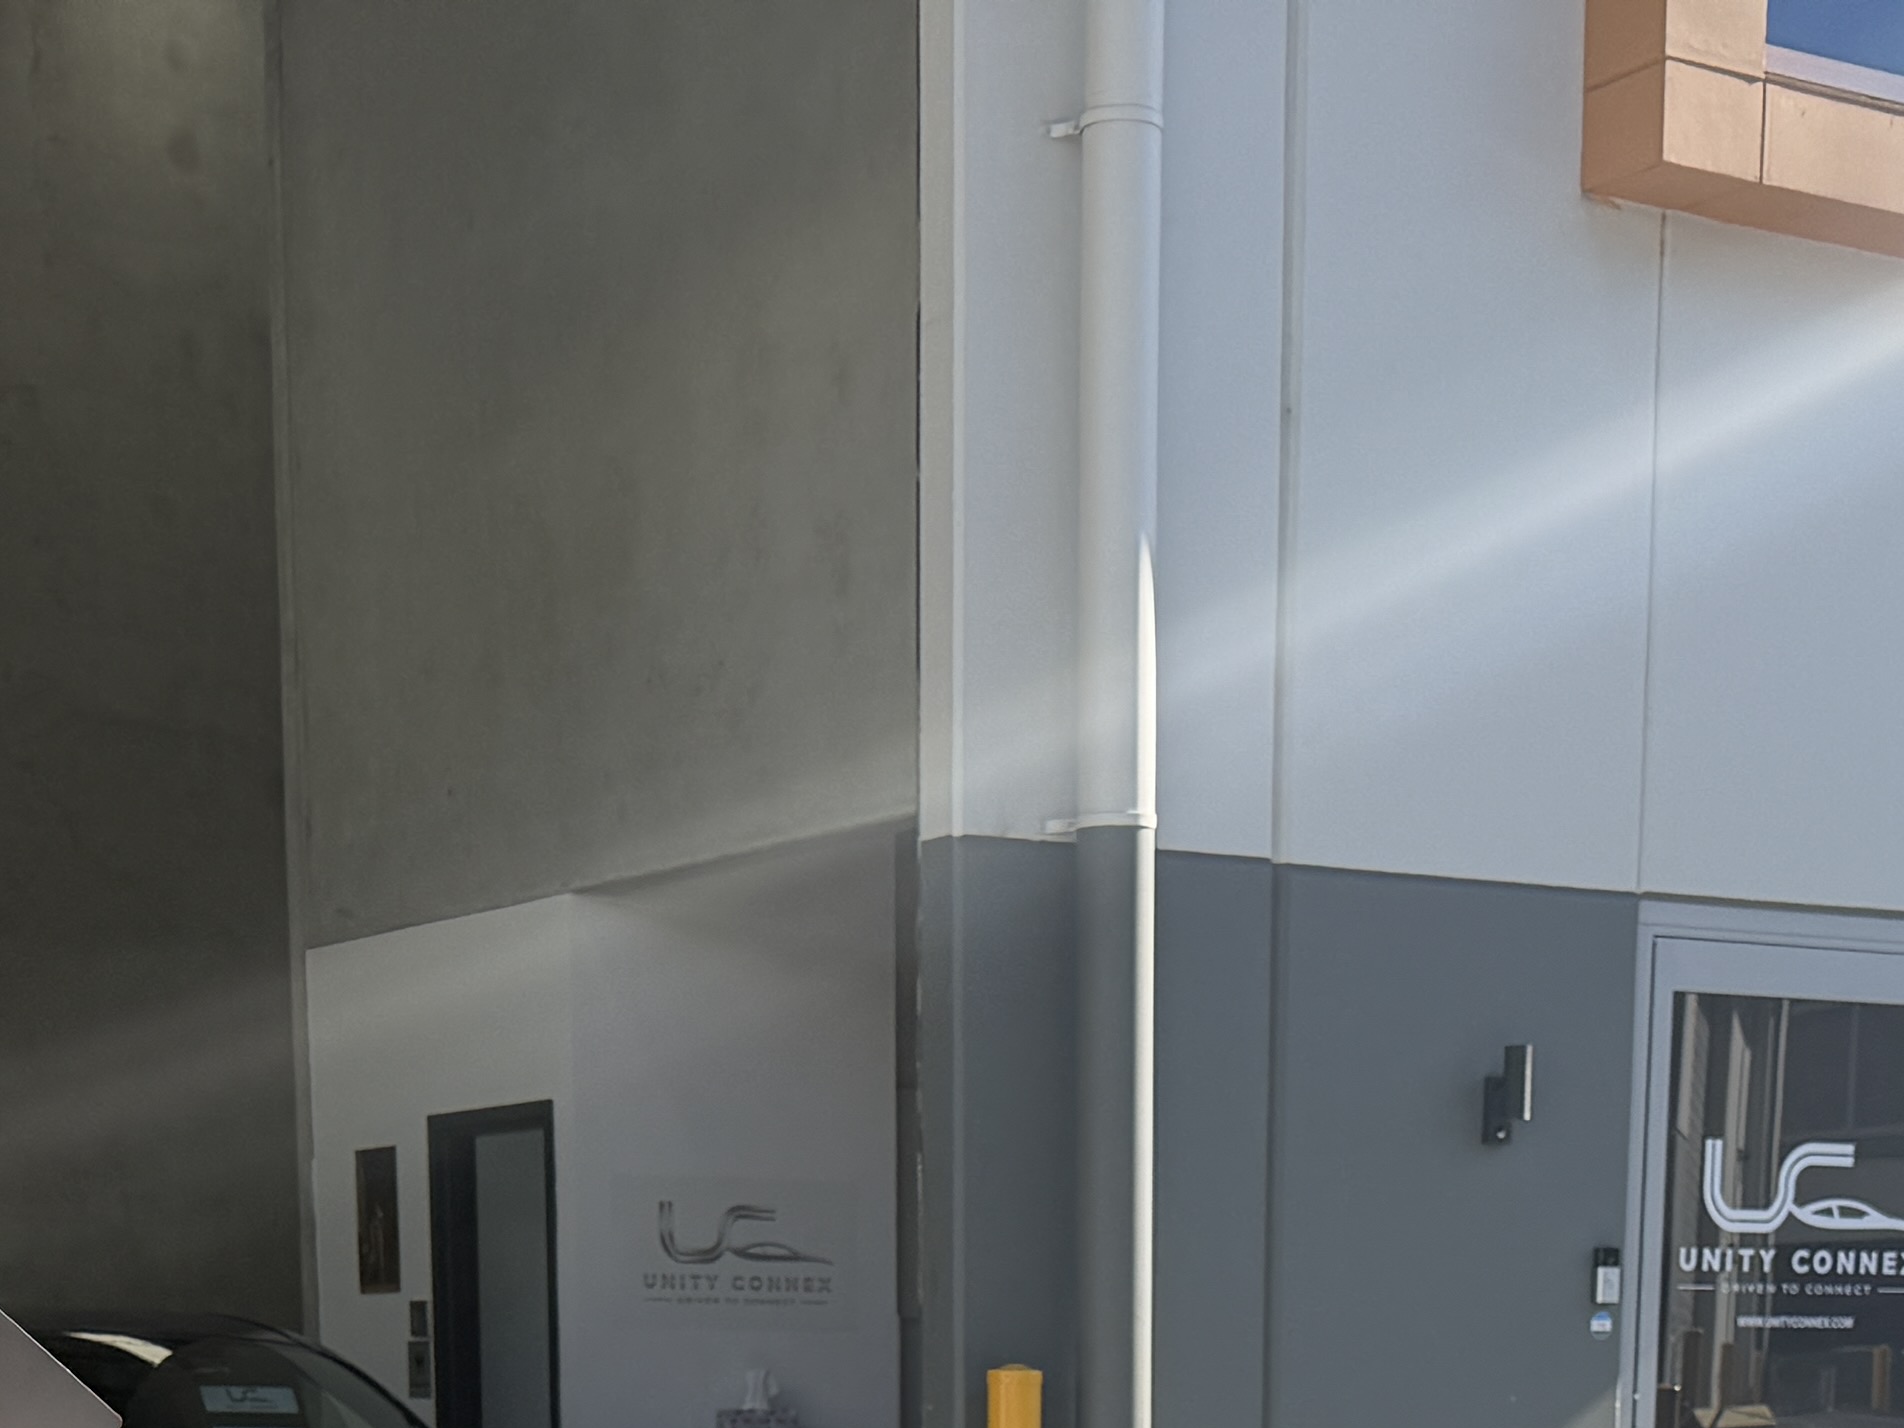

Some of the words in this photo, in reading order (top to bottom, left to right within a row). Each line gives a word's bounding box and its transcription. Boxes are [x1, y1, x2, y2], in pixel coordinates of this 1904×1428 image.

[1677, 1246, 1778, 1274] UNITY
[642, 1271, 719, 1292] UNITY
[731, 1274, 833, 1294] CONNEX
[1782, 1283, 1801, 1296] TO
[1804, 1284, 1874, 1297] CONNECT
